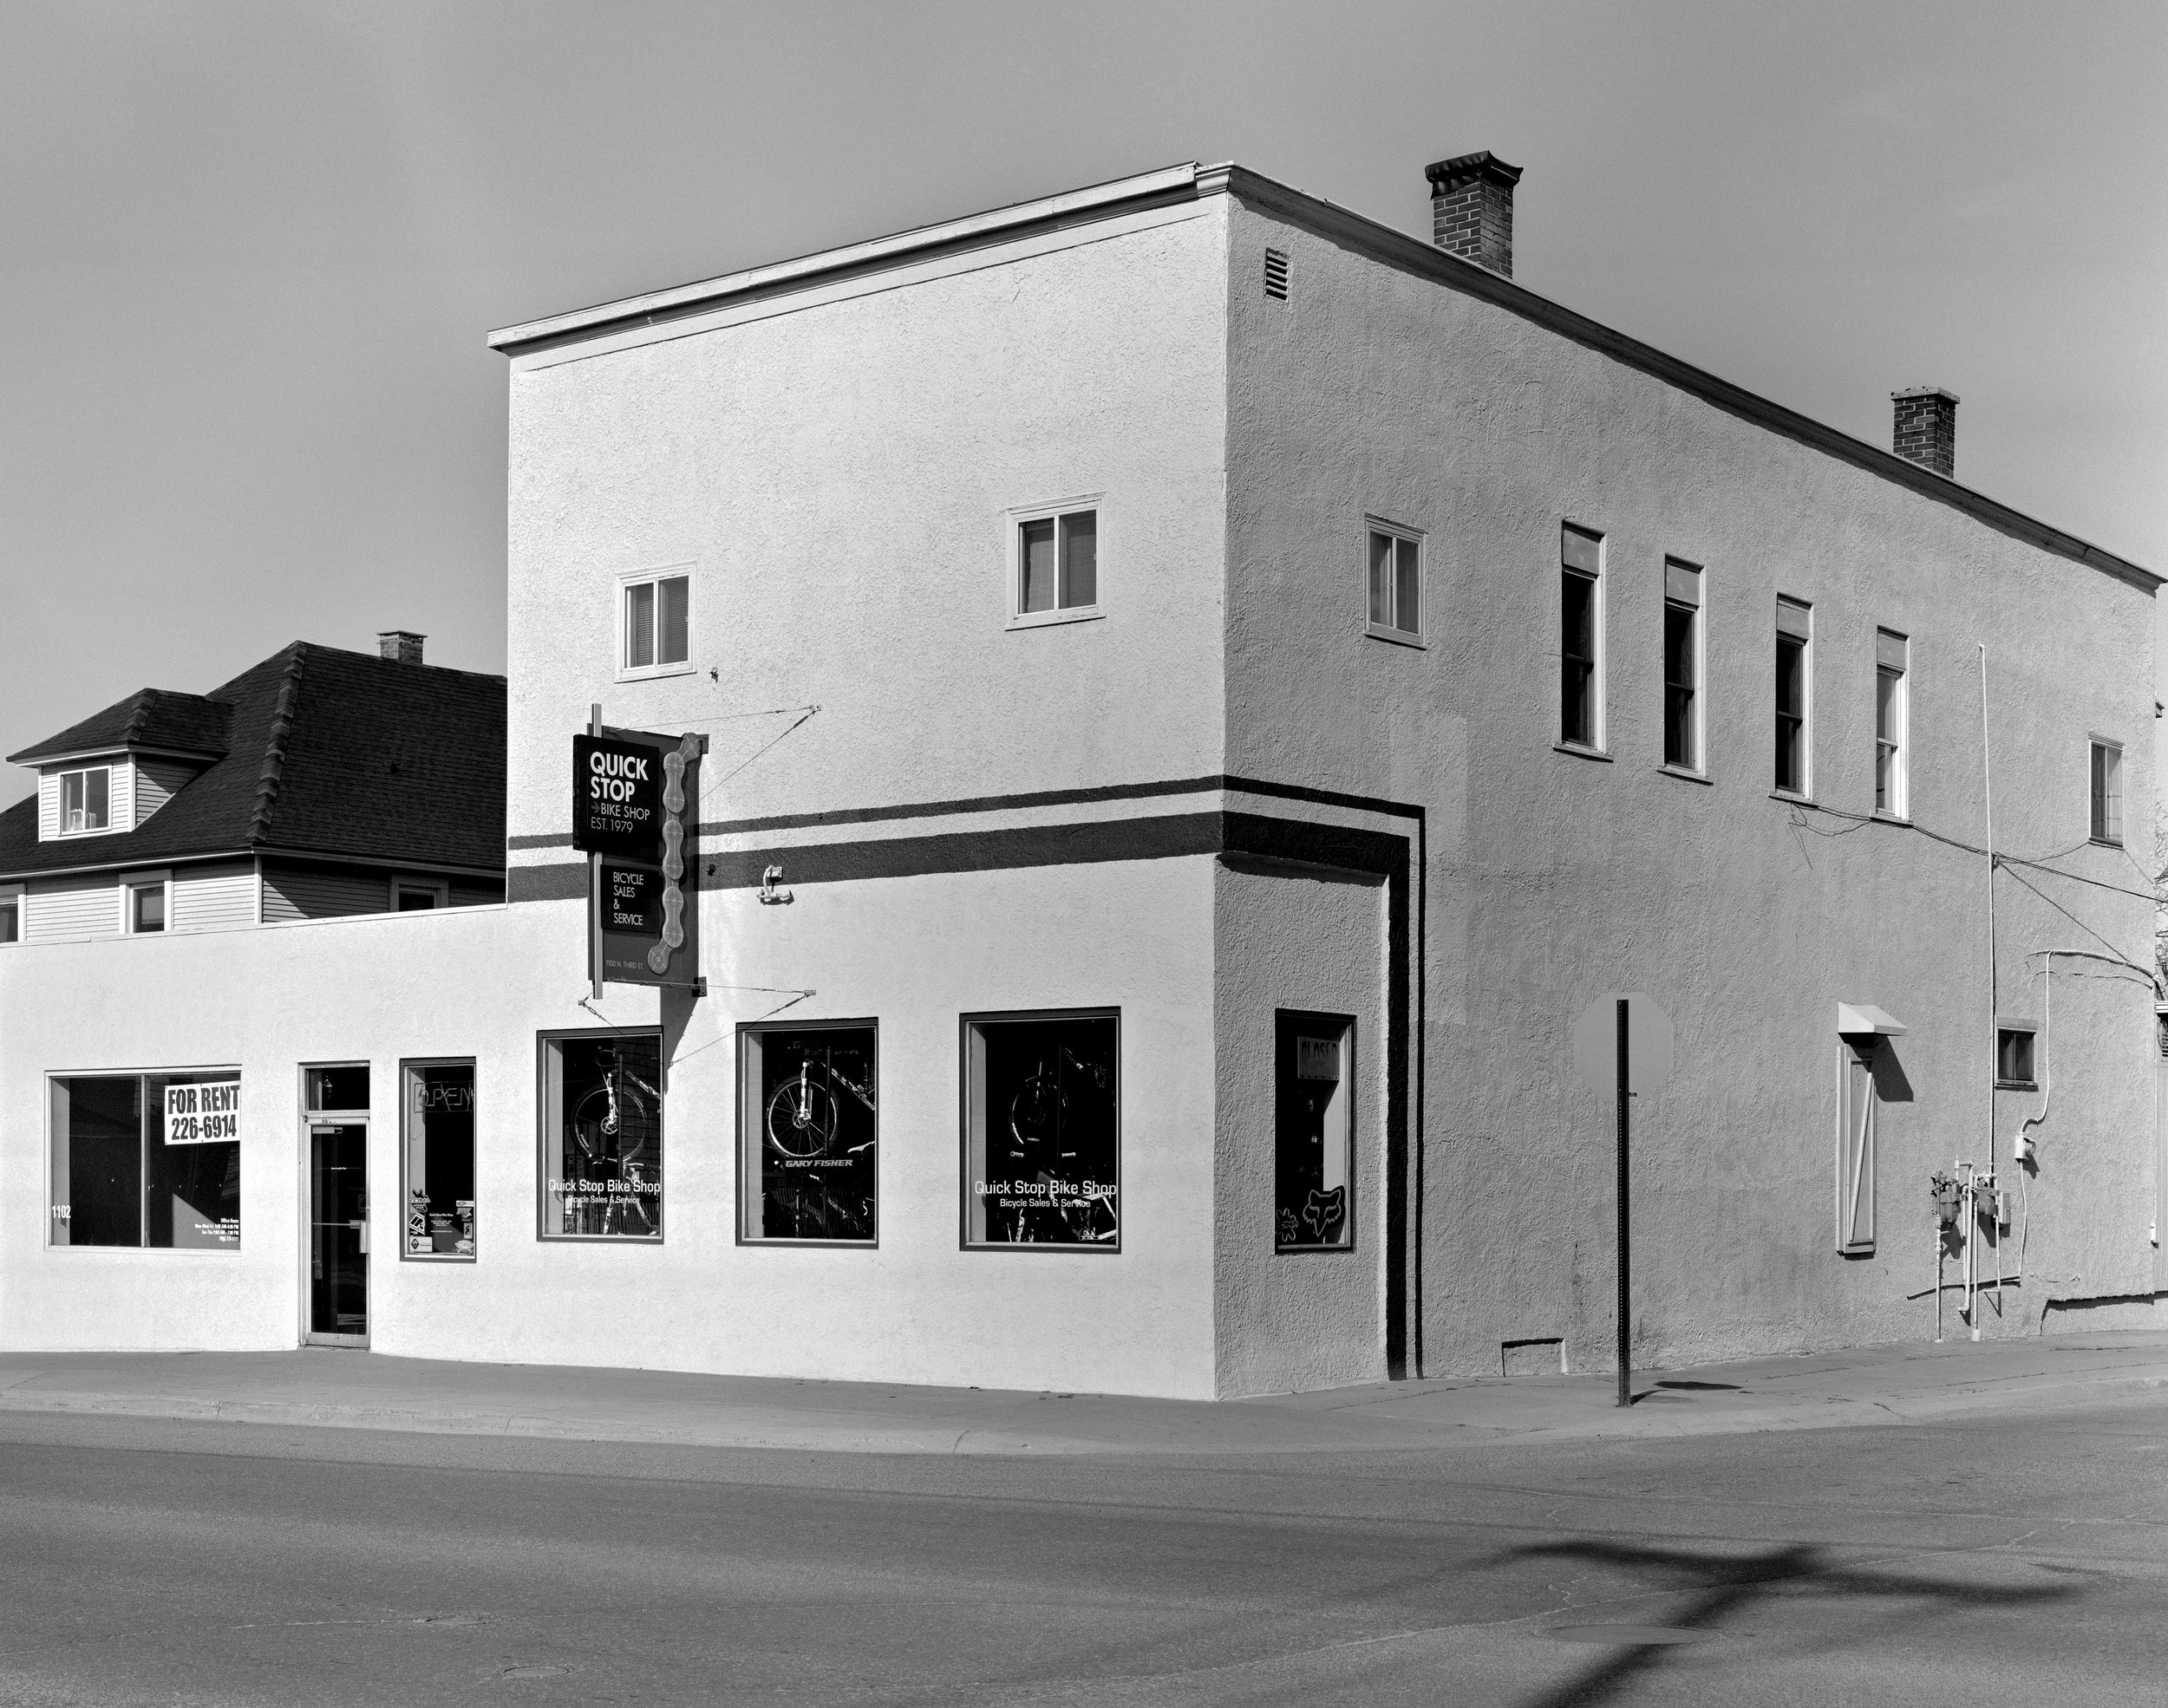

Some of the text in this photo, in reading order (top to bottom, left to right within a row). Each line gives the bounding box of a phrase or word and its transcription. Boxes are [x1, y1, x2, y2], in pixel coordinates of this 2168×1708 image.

[590, 751, 649, 781] QUICK
[590, 775, 636, 802] STOP
[601, 802, 650, 821] BIKE SHOP
[591, 816, 633, 833] EST. 1979
[613, 871, 644, 885] BICYCLE
[613, 884, 636, 898] SALES
[613, 898, 620, 909] &
[613, 912, 643, 926] SERVICE
[623, 961, 637, 969] THIRD
[167, 1085, 240, 1115] FOR RENT
[419, 1085, 473, 1107] OPEN
[171, 1114, 237, 1141] 226-6914
[548, 1178, 661, 1196] Quick Stop Bike Shop
[974, 1180, 1117, 1198] Quick Stop Bike Shop
[567, 1195, 590, 1203] Bicycle
[1000, 1198, 1028, 1209] Bicycle
[1028, 1198, 1050, 1208] Sales
[1061, 1199, 1091, 1208] Service
[51, 1205, 72, 1219] 1102
